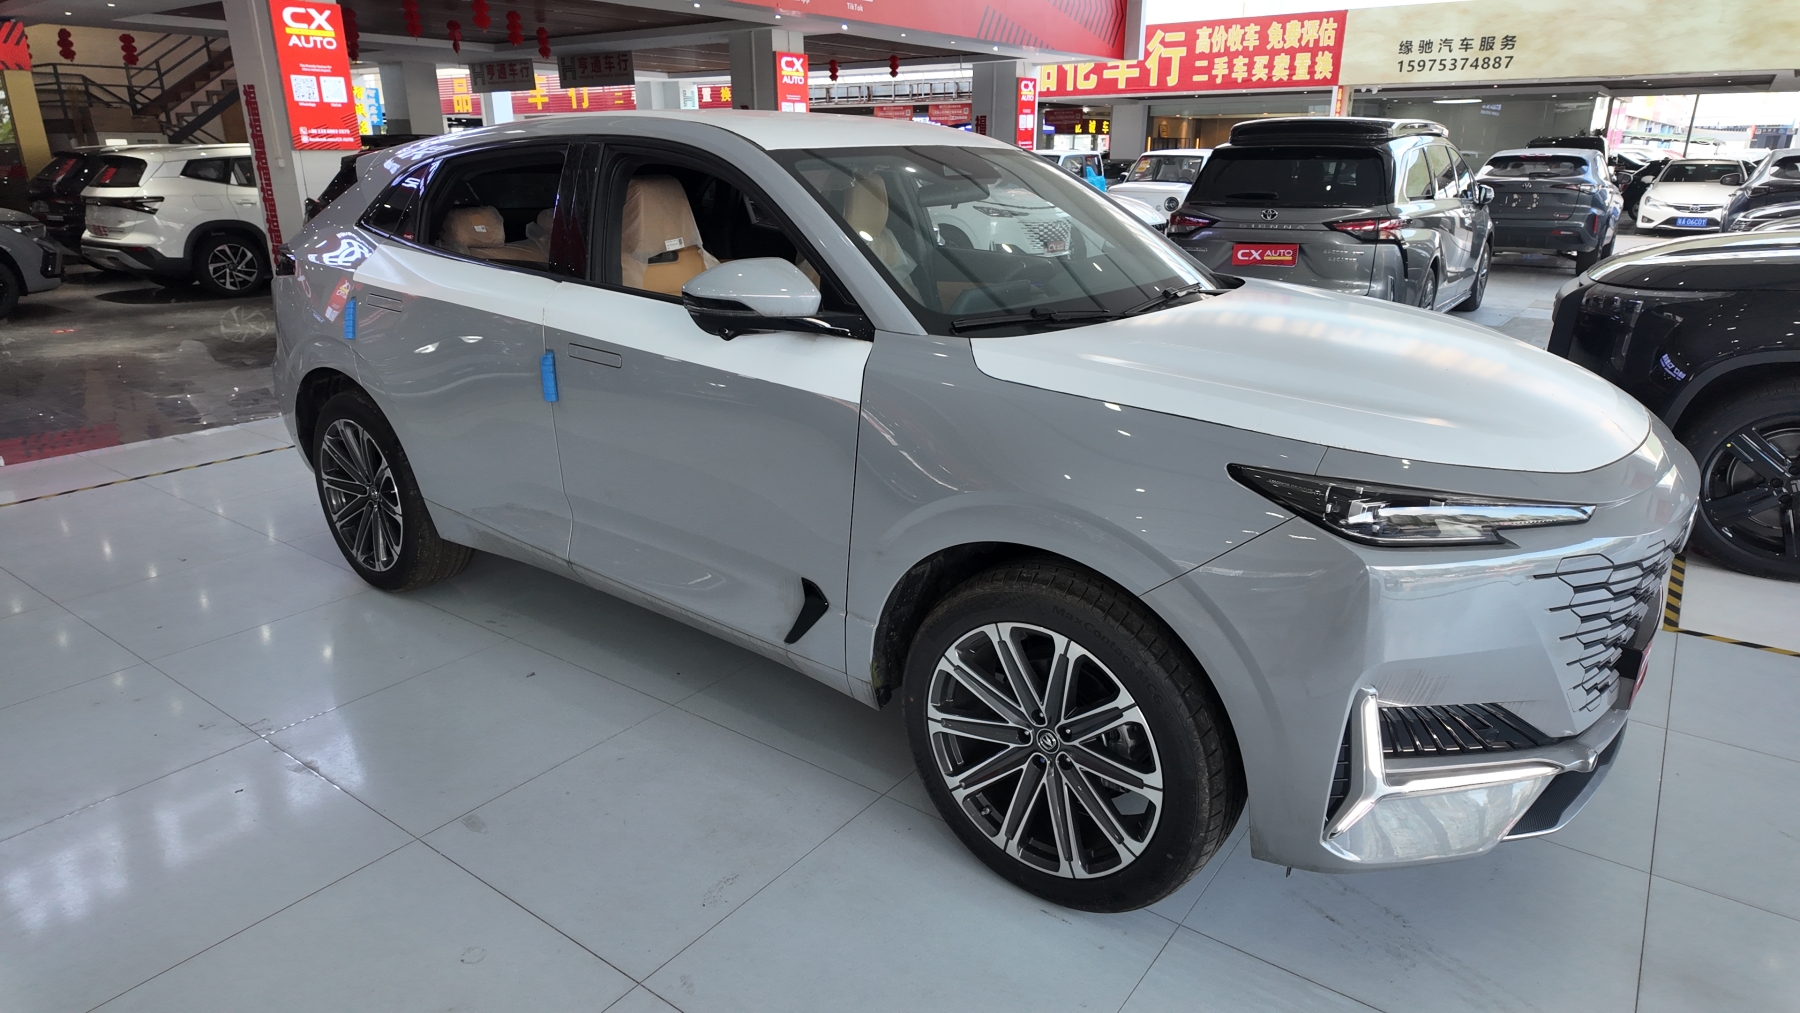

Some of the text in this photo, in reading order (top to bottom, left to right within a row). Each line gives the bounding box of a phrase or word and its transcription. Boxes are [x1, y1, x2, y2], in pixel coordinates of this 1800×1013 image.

[282, 6, 334, 31] CX
[288, 35, 337, 50] AUTO
[1195, 17, 1338, 55] 高价收车 免费评估
[1398, 34, 1517, 55] 缘驰汽车服务
[780, 56, 804, 72] CX
[1192, 50, 1334, 84] 二手车买卖置换
[1397, 55, 1514, 73] 15975374887
[782, 76, 805, 85] AUTO
[1020, 80, 1034, 92] CX
[1020, 94, 1035, 102] AUTO
[1237, 249, 1293, 260] CX AUTO
[1052, 605, 1137, 670] MaxContact
